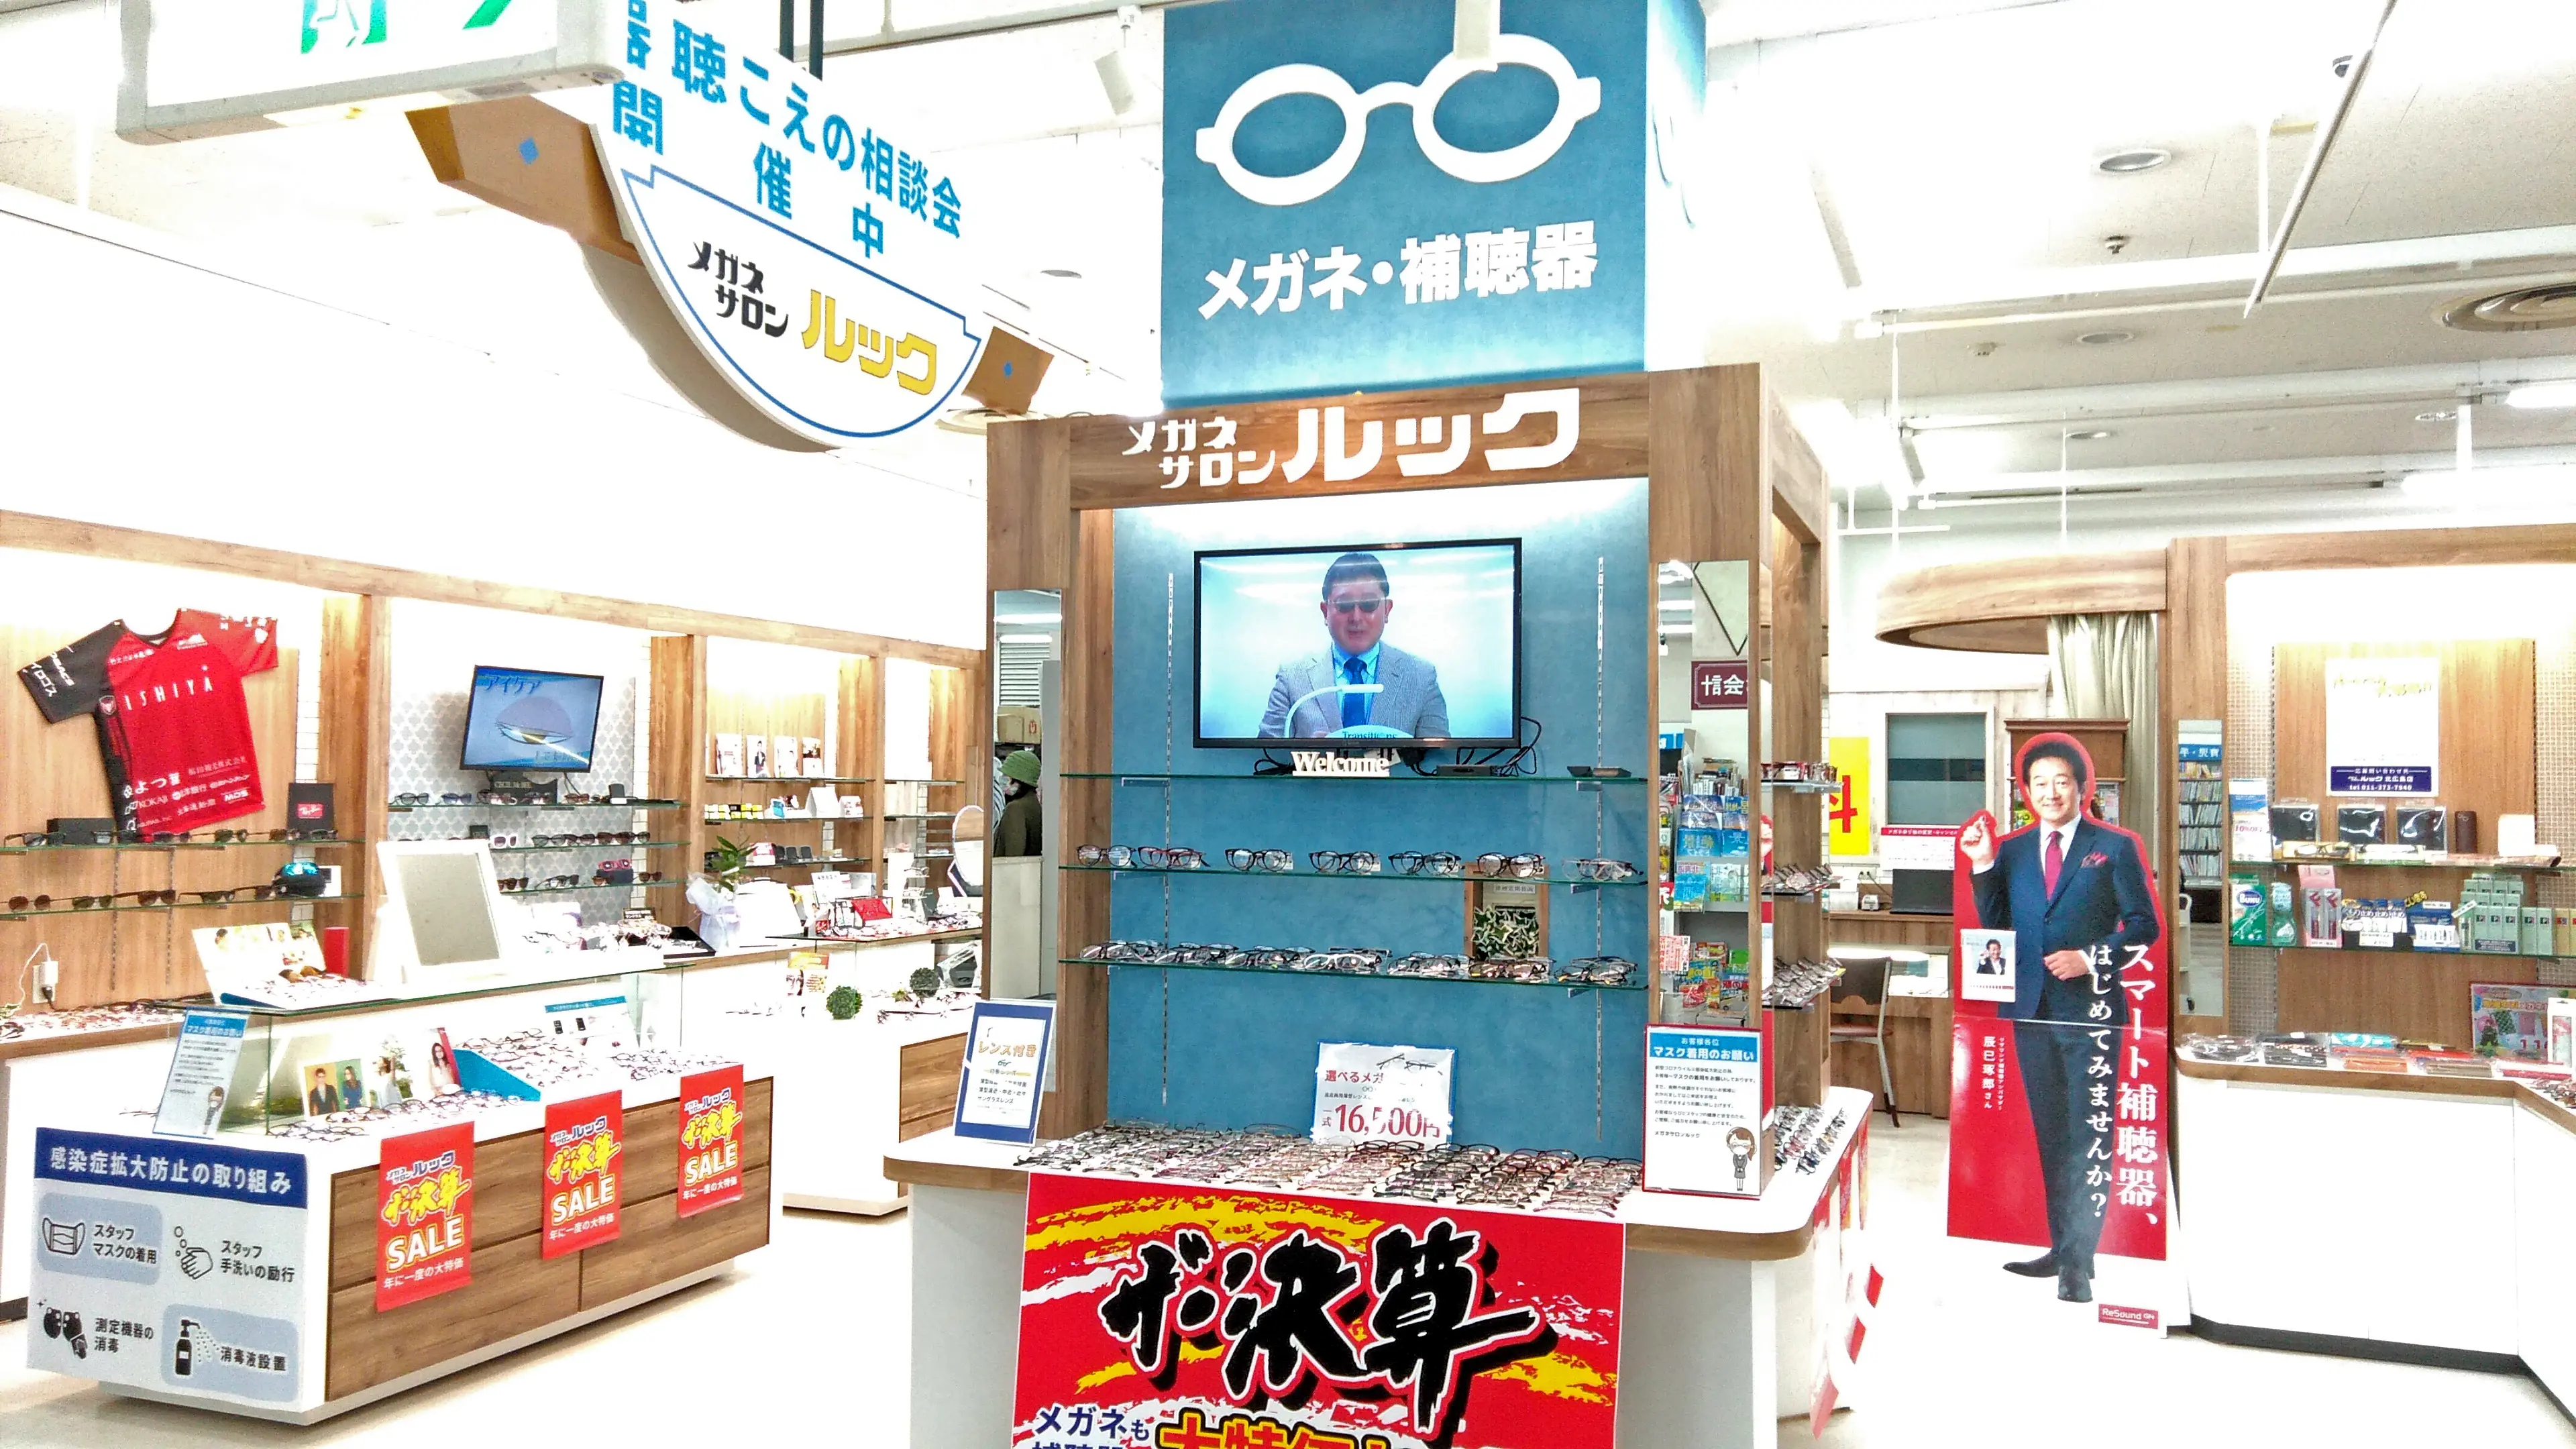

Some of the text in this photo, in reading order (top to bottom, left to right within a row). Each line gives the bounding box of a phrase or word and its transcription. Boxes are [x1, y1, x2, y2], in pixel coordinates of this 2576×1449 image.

[672, 18, 961, 239] 聴こえの相談会
[688, 241, 764, 293] メガネ
[1197, 219, 1599, 320] メガネ・補聴器
[715, 284, 789, 337] サロン
[801, 289, 937, 396] ルック
[1122, 416, 1238, 456] メガネ
[1281, 387, 1580, 484] ルック
[1159, 449, 1276, 490] サロン
[123, 676, 214, 711] ISHIYA
[1291, 751, 1389, 773] Welcome
[1653, 1046, 1755, 1061] マスク着用のお願い
[50, 1144, 292, 1195] 感染症拡大防止の取り組み
[684, 1140, 738, 1186] SALE
[551, 1173, 615, 1227] SALE
[92, 1241, 158, 1265] マスクの着用
[93, 1224, 135, 1241] スタッフ
[221, 1240, 262, 1259] スタッフ
[386, 1215, 464, 1272] SALE
[94, 1336, 119, 1354] 消毒
[220, 1346, 287, 1372] 消毒液設置
